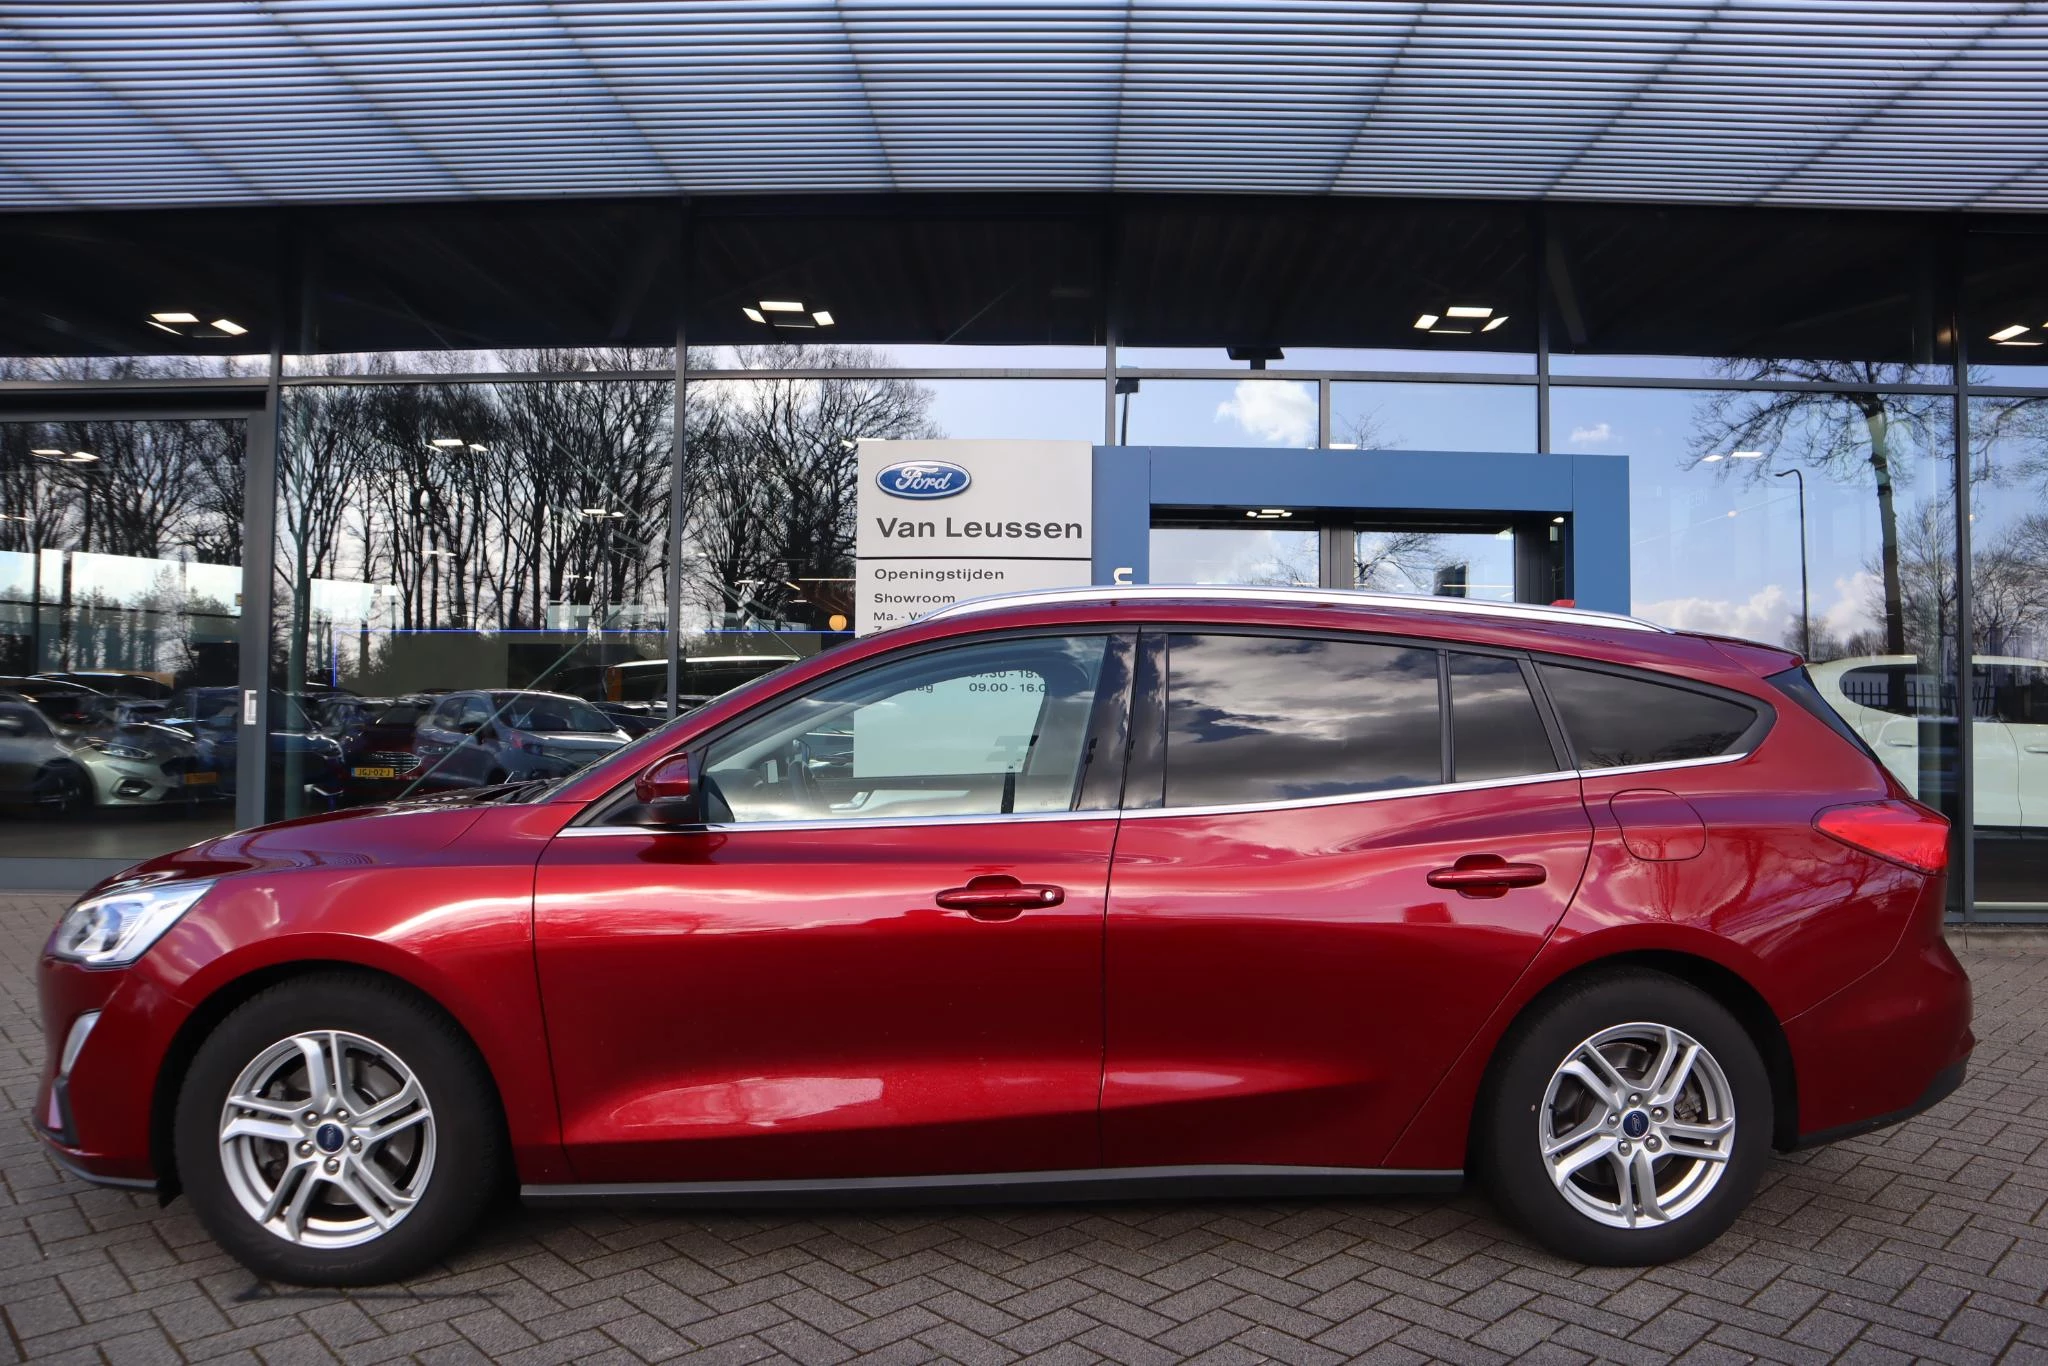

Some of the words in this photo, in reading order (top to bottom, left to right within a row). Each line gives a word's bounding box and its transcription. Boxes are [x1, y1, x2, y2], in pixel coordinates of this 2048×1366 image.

[895, 466, 953, 490] Ford
[876, 517, 935, 538] Van
[946, 517, 1083, 539] Leussen
[874, 568, 1005, 582] Openingstijden
[874, 593, 956, 604] Showroom
[873, 611, 898, 621] Ma.
[969, 683, 1008, 693] 09.00
[1019, 683, 1046, 693] 16.0
